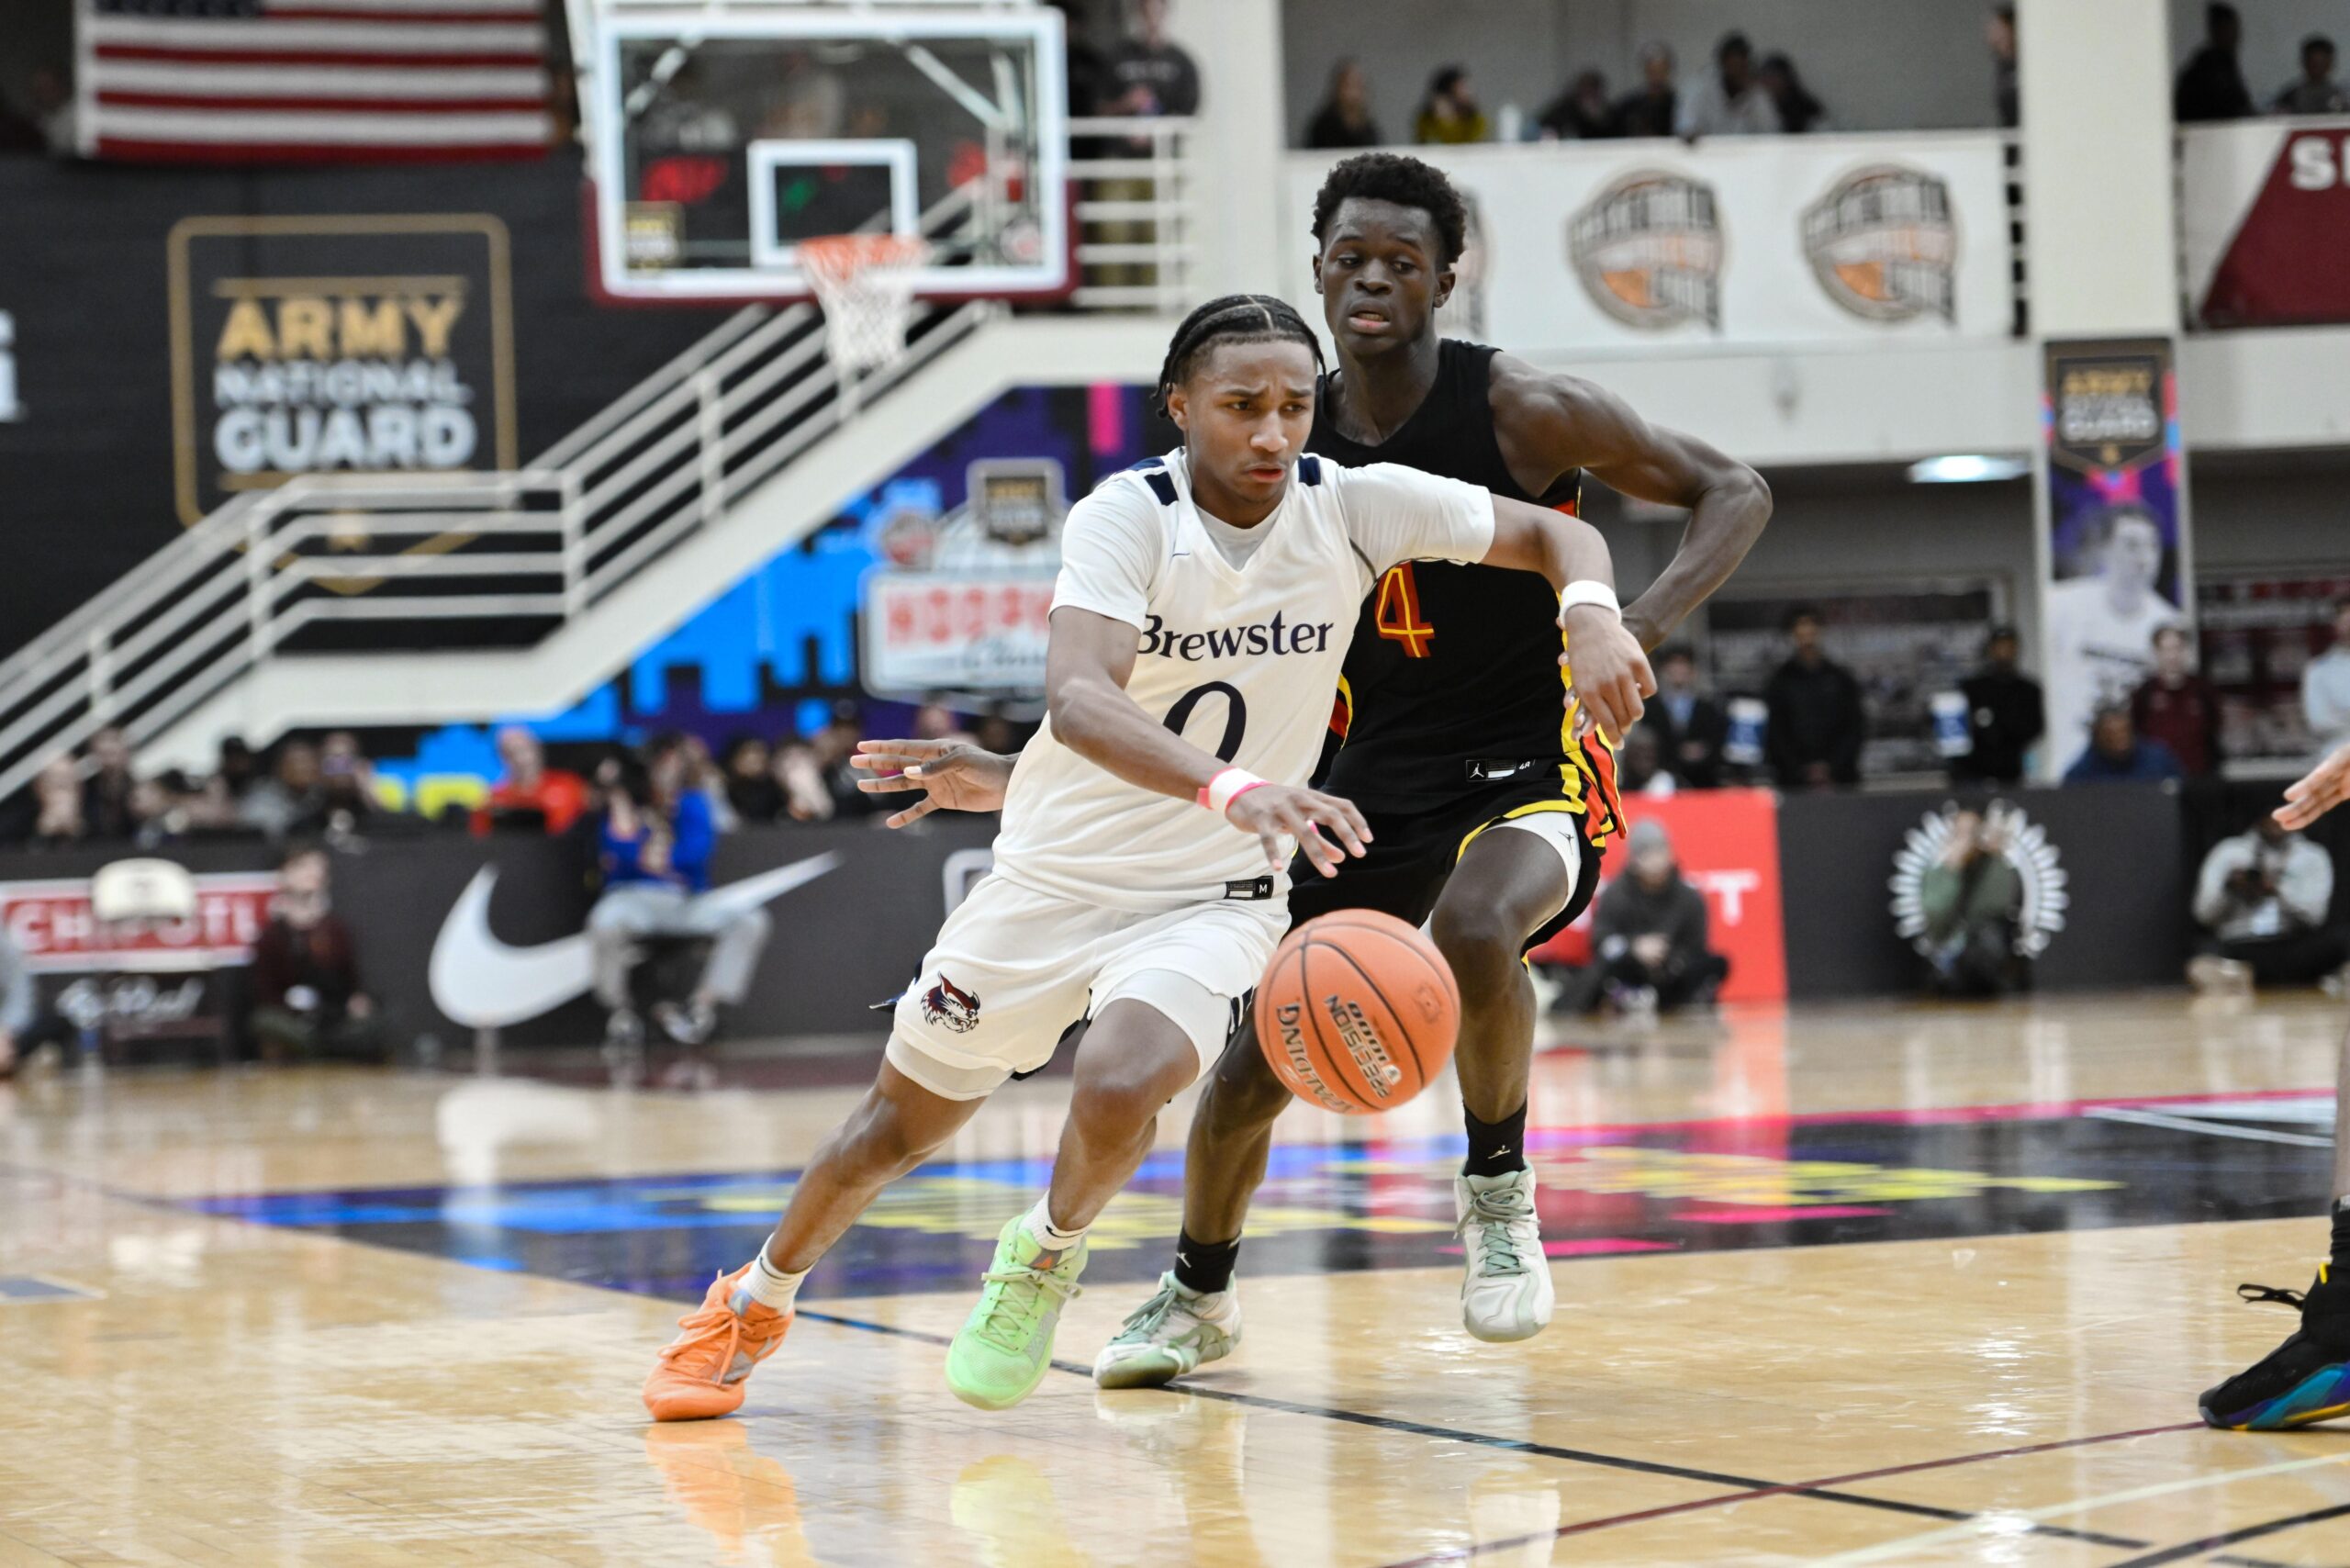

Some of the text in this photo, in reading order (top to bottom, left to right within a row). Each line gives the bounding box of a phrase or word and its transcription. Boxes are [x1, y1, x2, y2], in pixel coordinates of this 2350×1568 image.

[2291, 136, 2350, 190] S
[215, 297, 461, 360] ARMY
[214, 359, 474, 407] NATIONAL
[214, 406, 476, 473] GUARD
[1137, 610, 1334, 662] Brewster
[1375, 559, 1435, 658] 4
[1163, 680, 1247, 764] 0
[1259, 884, 1268, 894] M
[1325, 995, 1391, 1099] PRECISION
[1347, 1001, 1389, 1063] 1000
